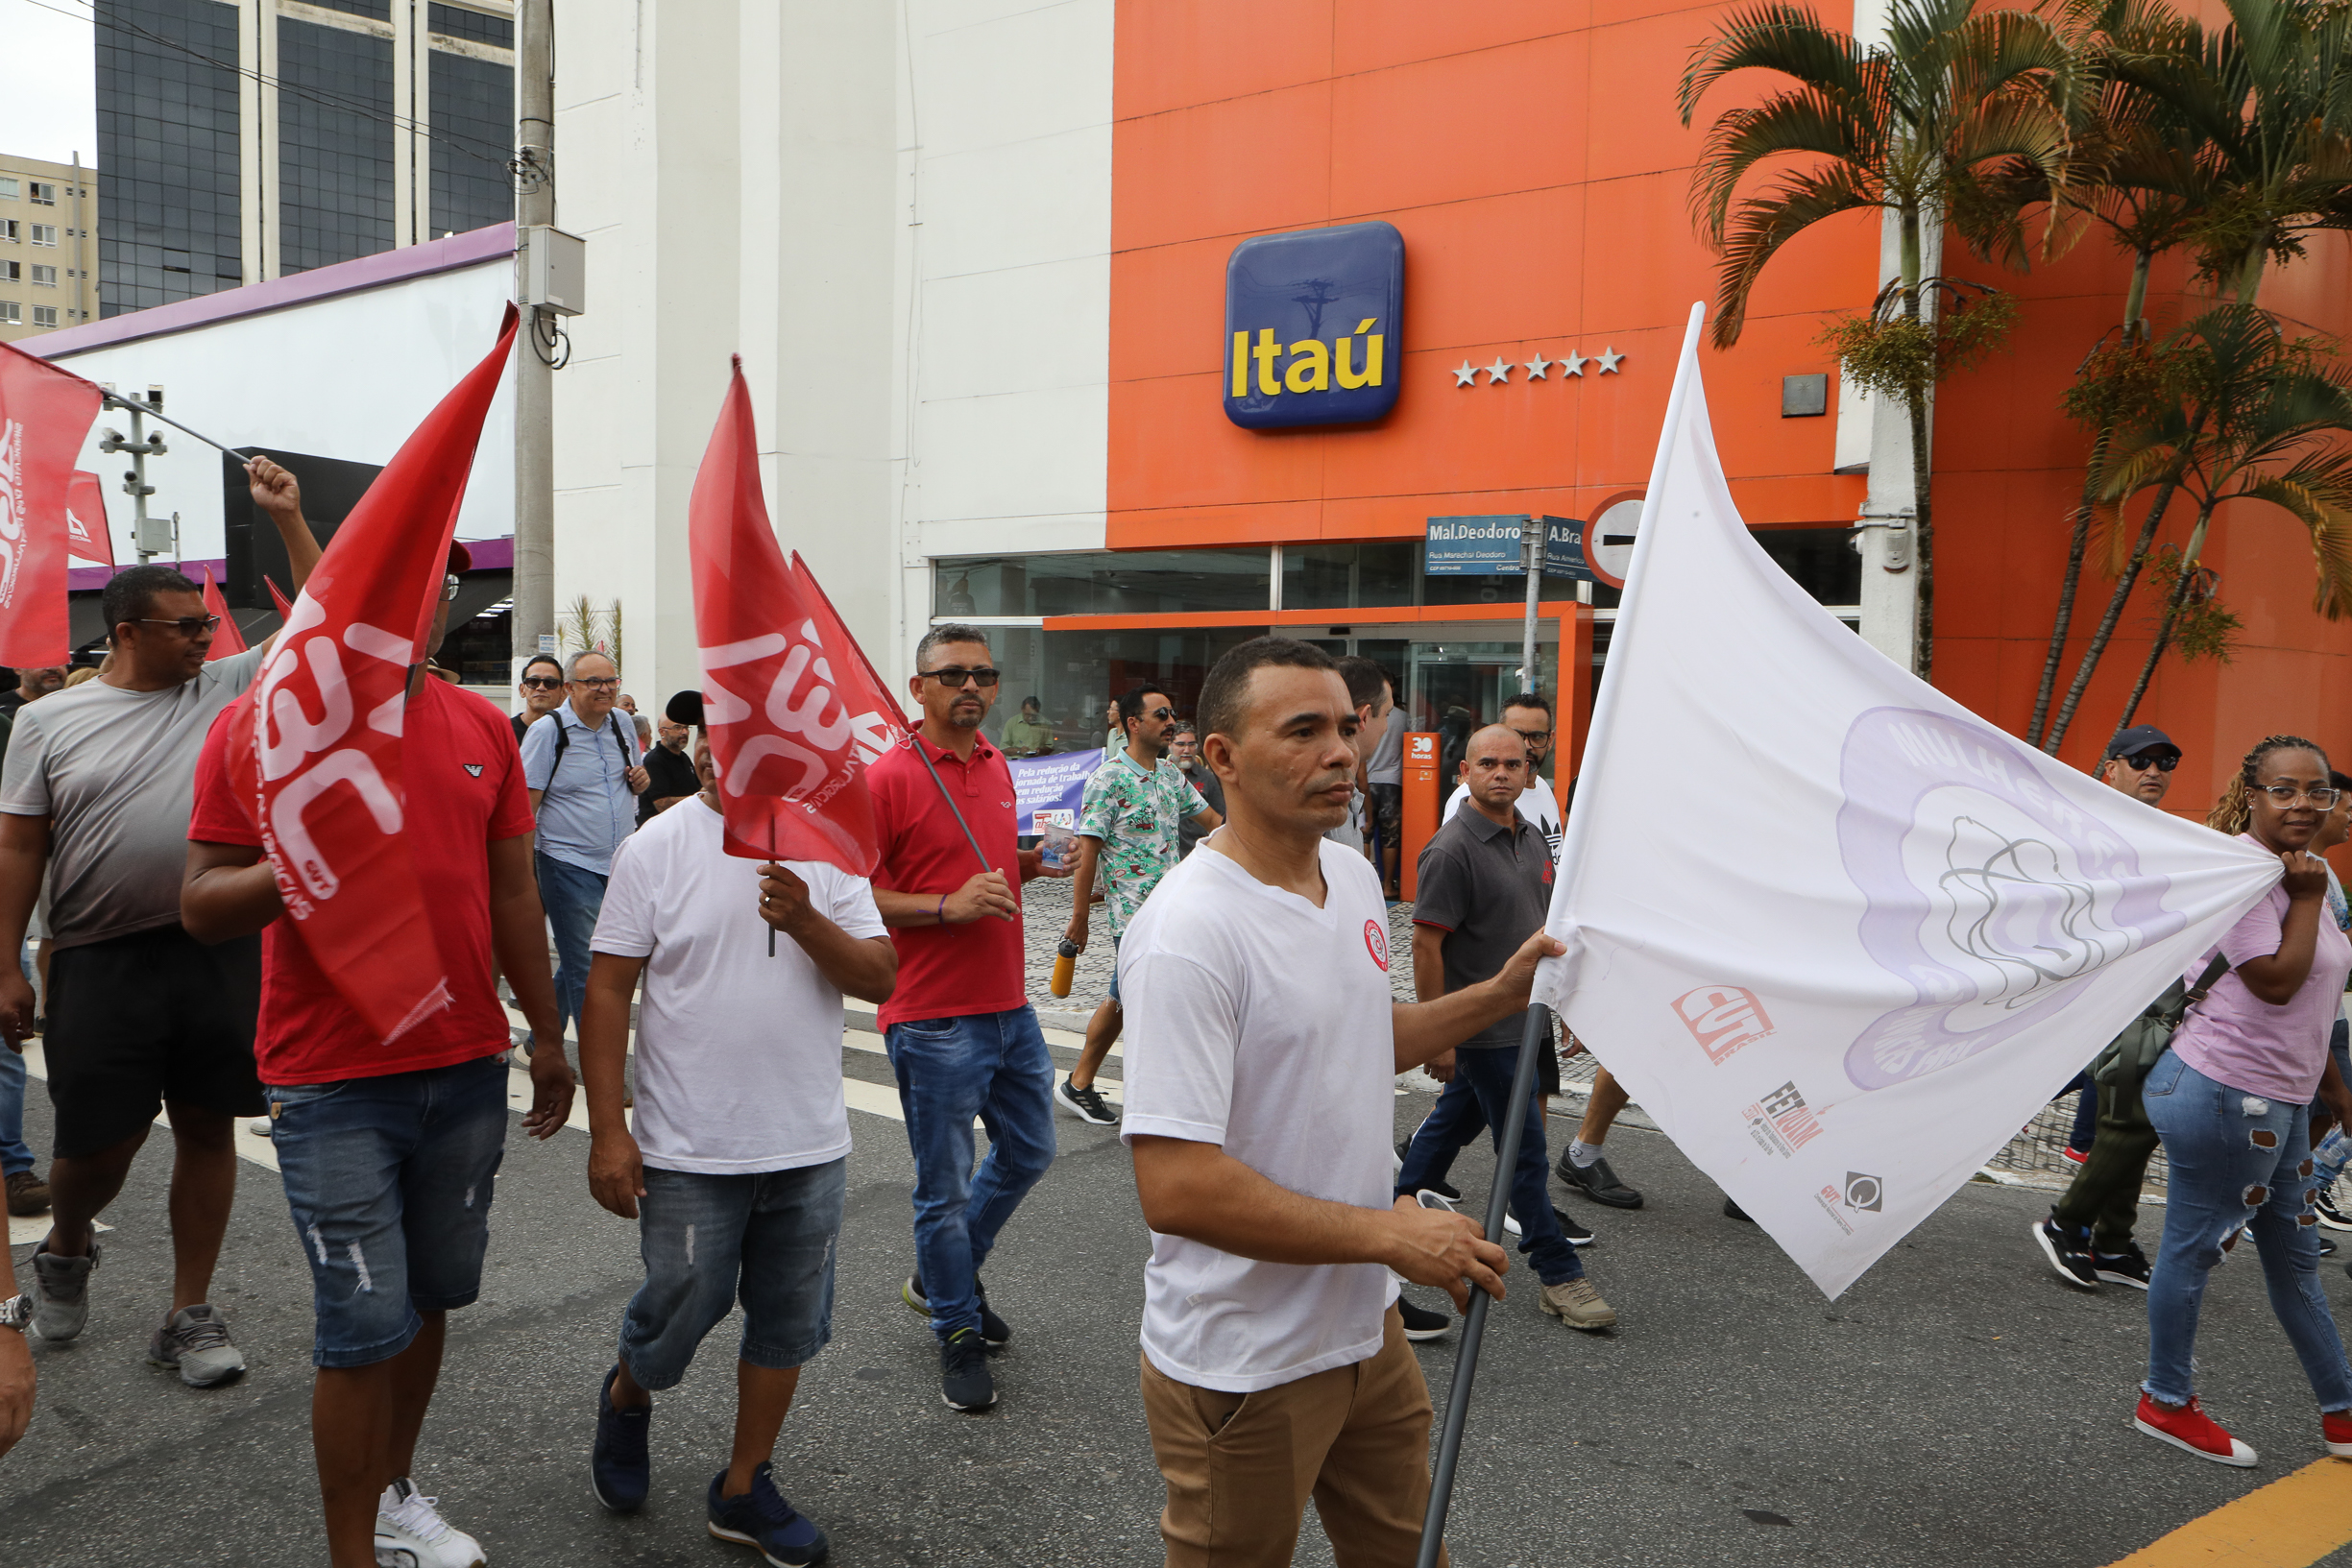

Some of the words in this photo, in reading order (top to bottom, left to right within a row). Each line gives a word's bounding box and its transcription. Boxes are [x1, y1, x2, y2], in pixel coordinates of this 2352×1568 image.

[1232, 317, 1384, 398] Itaú
[1548, 525, 1583, 545] A.Bra
[1546, 552, 1560, 561] Rua
[1412, 736, 1433, 753] 30
[1018, 767, 1035, 778] Pela
[1036, 763, 1068, 777] redução
[1070, 761, 1080, 771] da
[1015, 776, 1045, 787] jornada
[1048, 775, 1058, 784] de
[1031, 784, 1064, 796] redução
[303, 858, 332, 891] CUT
[1681, 986, 1765, 1053] CUT
[1713, 1030, 1778, 1067] BRASIL
[1820, 1184, 1842, 1203] CUT
